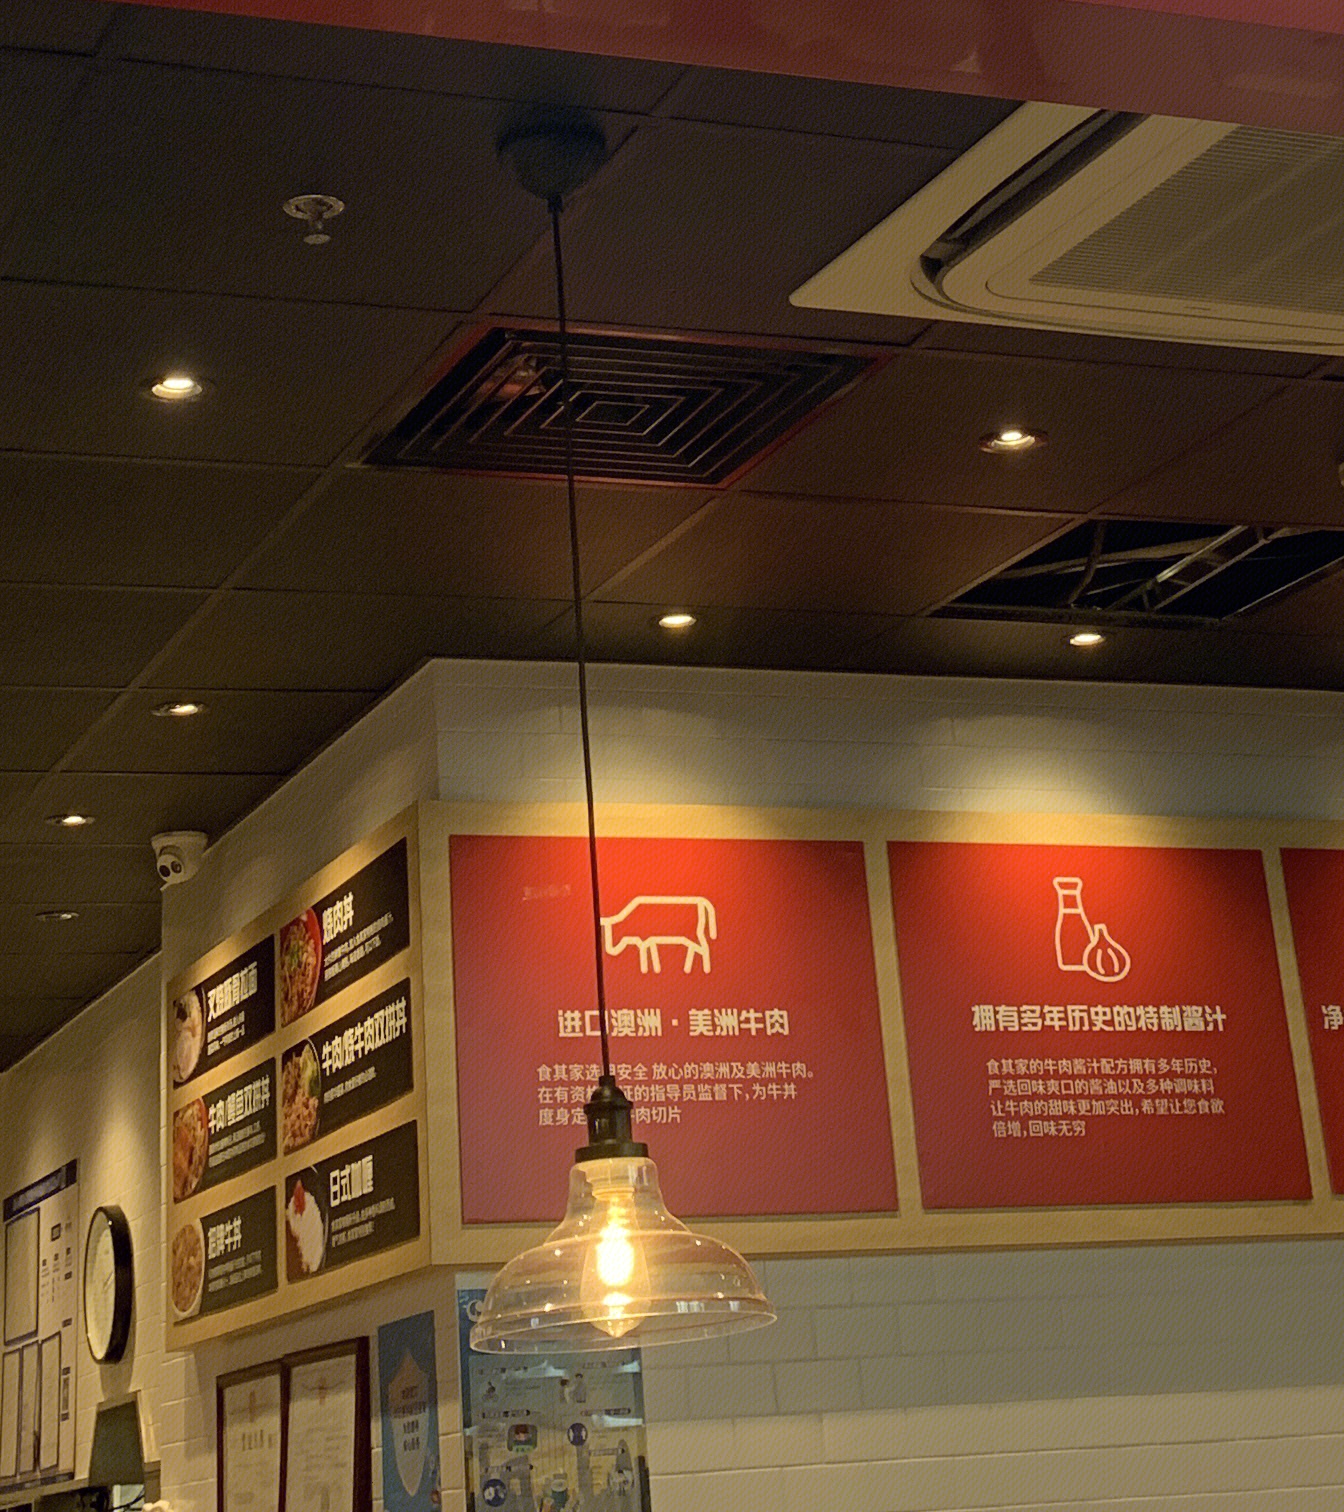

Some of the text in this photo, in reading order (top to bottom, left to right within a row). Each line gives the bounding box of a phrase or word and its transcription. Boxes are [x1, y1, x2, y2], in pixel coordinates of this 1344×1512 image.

[970, 1004, 1227, 1032] 拥有多年历史的特制酱汁
